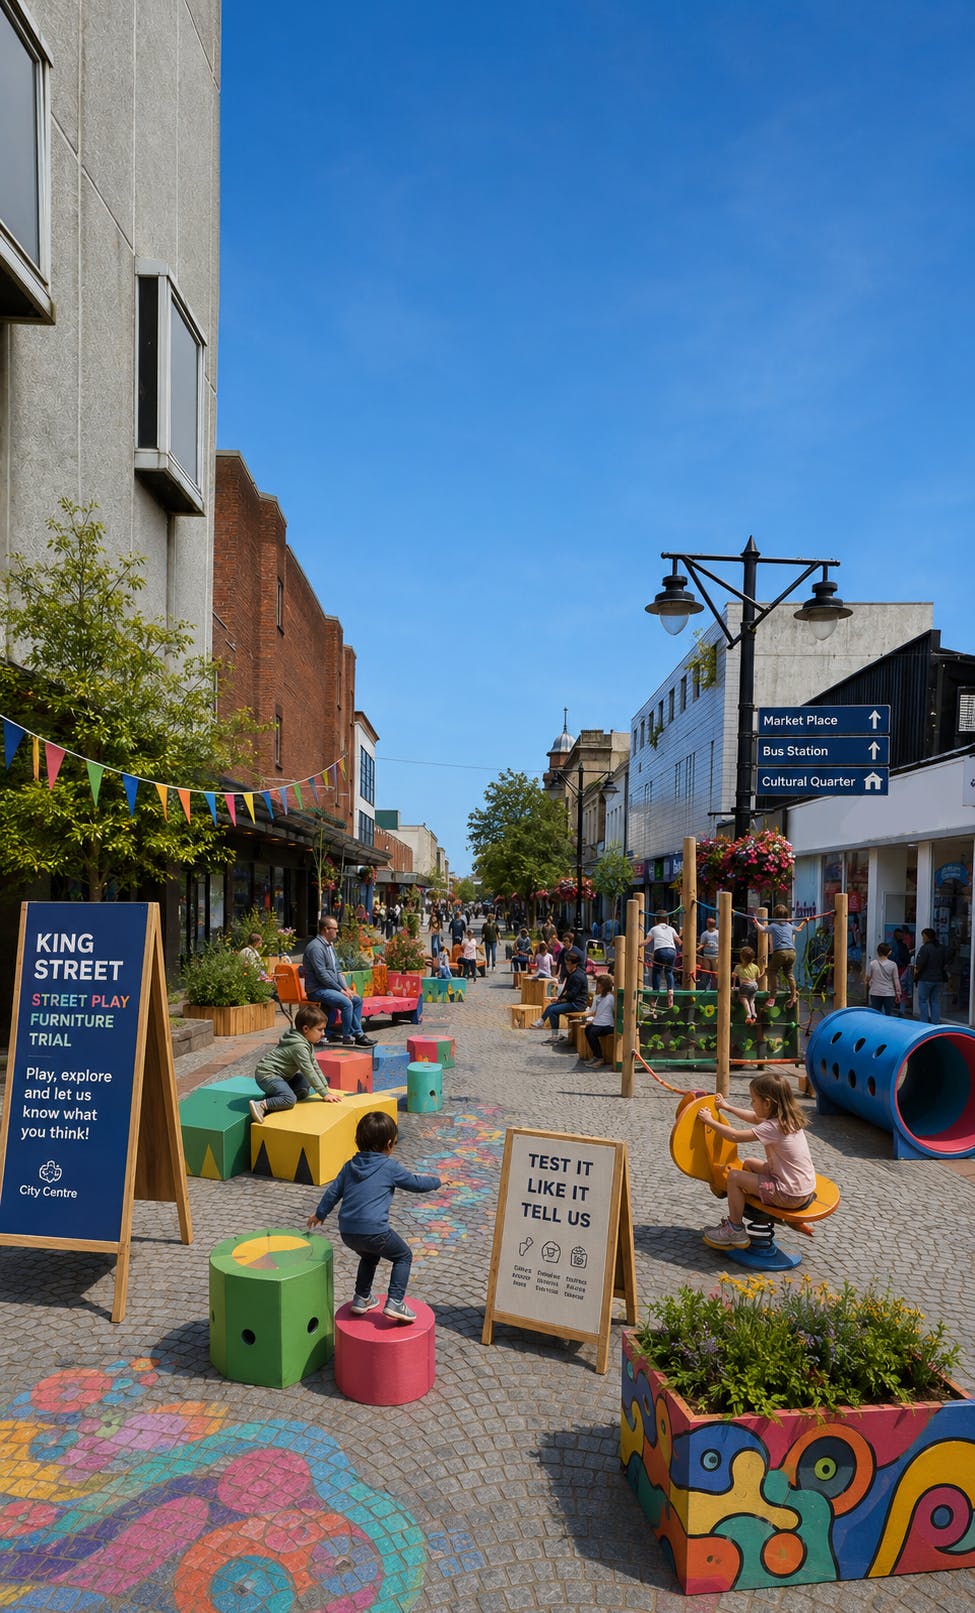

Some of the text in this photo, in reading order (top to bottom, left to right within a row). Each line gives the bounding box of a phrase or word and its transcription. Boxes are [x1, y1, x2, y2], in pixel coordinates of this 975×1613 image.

[763, 715, 838, 726] Market Place
[763, 745, 828, 756] Bus Station
[762, 776, 856, 788] Cultural Quarter
[36, 933, 94, 954] KING
[34, 960, 123, 981] STREET
[31, 993, 130, 1009] STREET PLAY
[30, 1013, 114, 1029] FURNITURE
[29, 1032, 72, 1047] TRIAL
[26, 1067, 113, 1085] Play, explore
[24, 1087, 92, 1101] and let us
[22, 1106, 98, 1121] know what
[21, 1127, 90, 1142] you think!
[528, 1153, 593, 1176] TEST IT
[19, 1184, 78, 1199] City Centre
[527, 1179, 590, 1202] LIKE IT
[521, 1202, 591, 1228] TELL US
